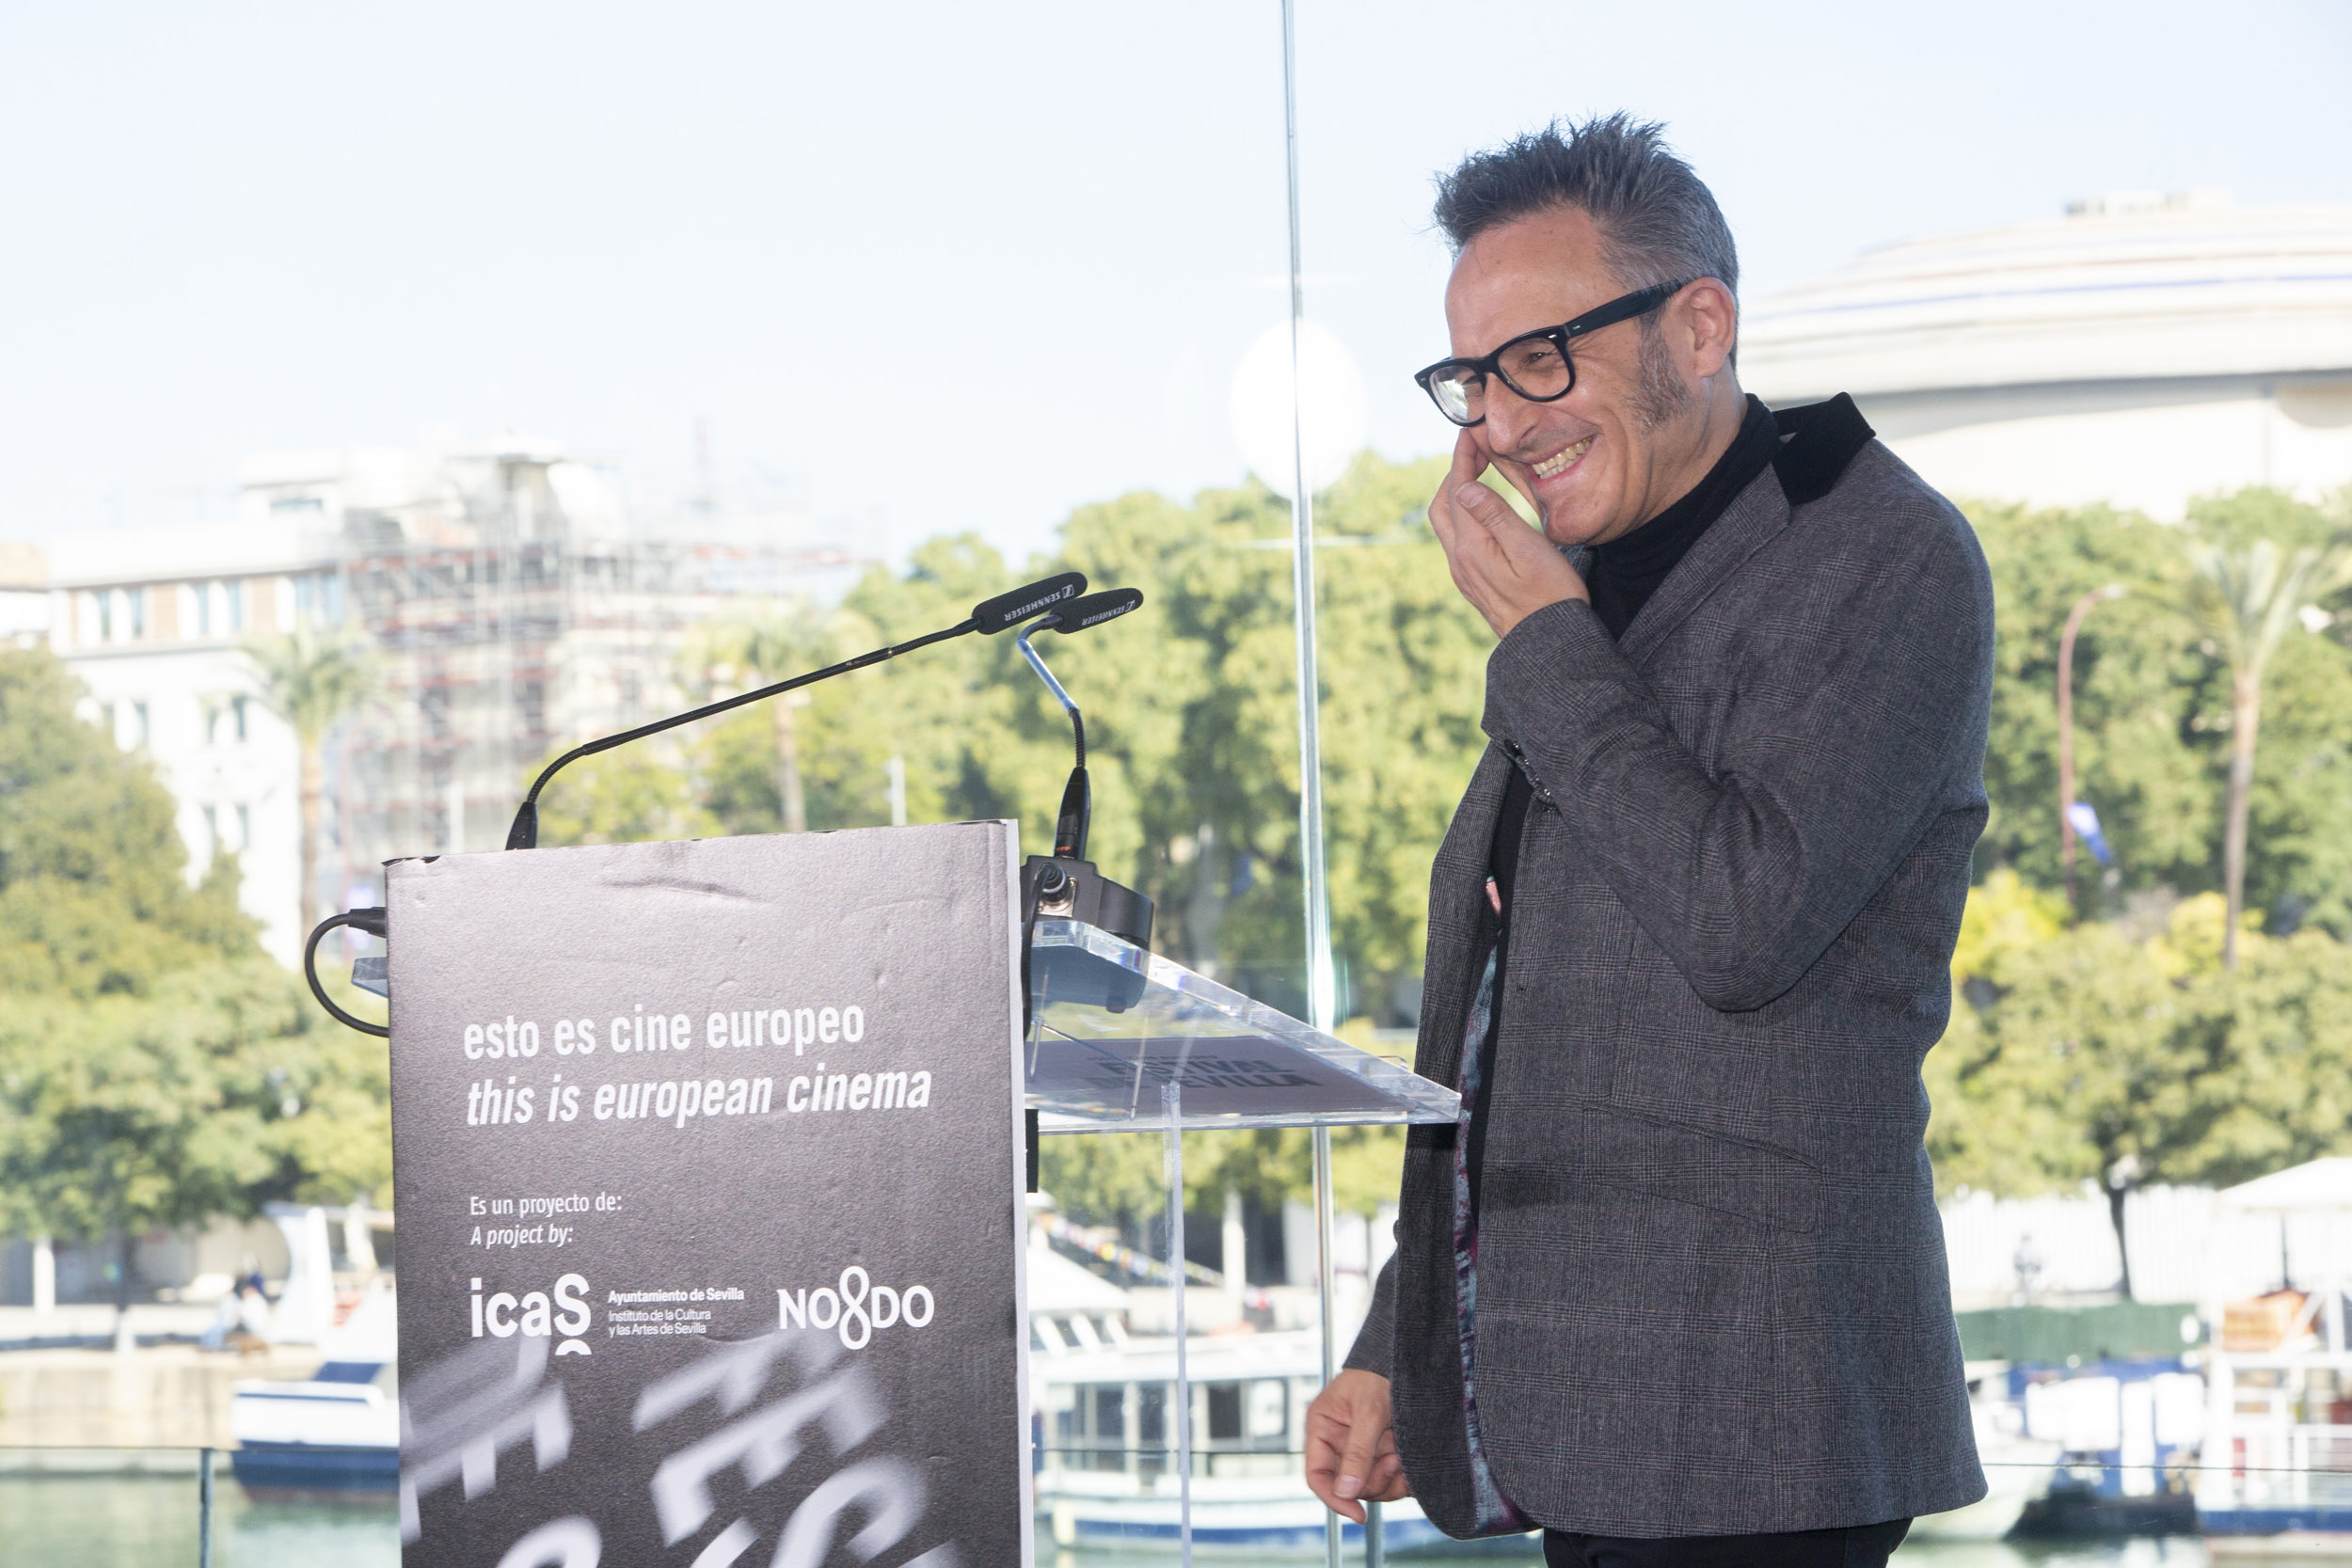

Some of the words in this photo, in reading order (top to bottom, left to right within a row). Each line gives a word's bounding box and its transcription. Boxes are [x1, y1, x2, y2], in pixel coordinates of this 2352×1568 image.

[1004, 592, 1061, 621] SENNHEISER
[1082, 605, 1126, 626] SENNHEISER
[465, 1015, 539, 1060] esto
[554, 1019, 596, 1055] es
[610, 1004, 691, 1053] cine
[707, 1006, 865, 1056] europeo
[468, 1075, 535, 1125] this
[548, 1073, 581, 1122] is
[594, 1077, 773, 1129] european
[787, 1062, 932, 1114] cinema
[470, 1196, 487, 1215] Es
[492, 1198, 514, 1215] un
[519, 1194, 590, 1219] proyecto
[595, 1192, 623, 1212] de:
[470, 1226, 482, 1245] A
[485, 1225, 544, 1250] project
[548, 1224, 574, 1248] by:
[608, 1289, 689, 1306] Ayuntamiento
[690, 1289, 706, 1302] de
[707, 1287, 745, 1301] Sevilla
[609, 1308, 649, 1323] Instituto
[650, 1309, 664, 1322] de
[665, 1308, 675, 1322] la
[675, 1308, 711, 1321] Cultura
[609, 1325, 616, 1338] y
[616, 1324, 631, 1336] las
[631, 1323, 659, 1336] Artes
[660, 1323, 674, 1335] de
[675, 1322, 707, 1335] Sevilla
